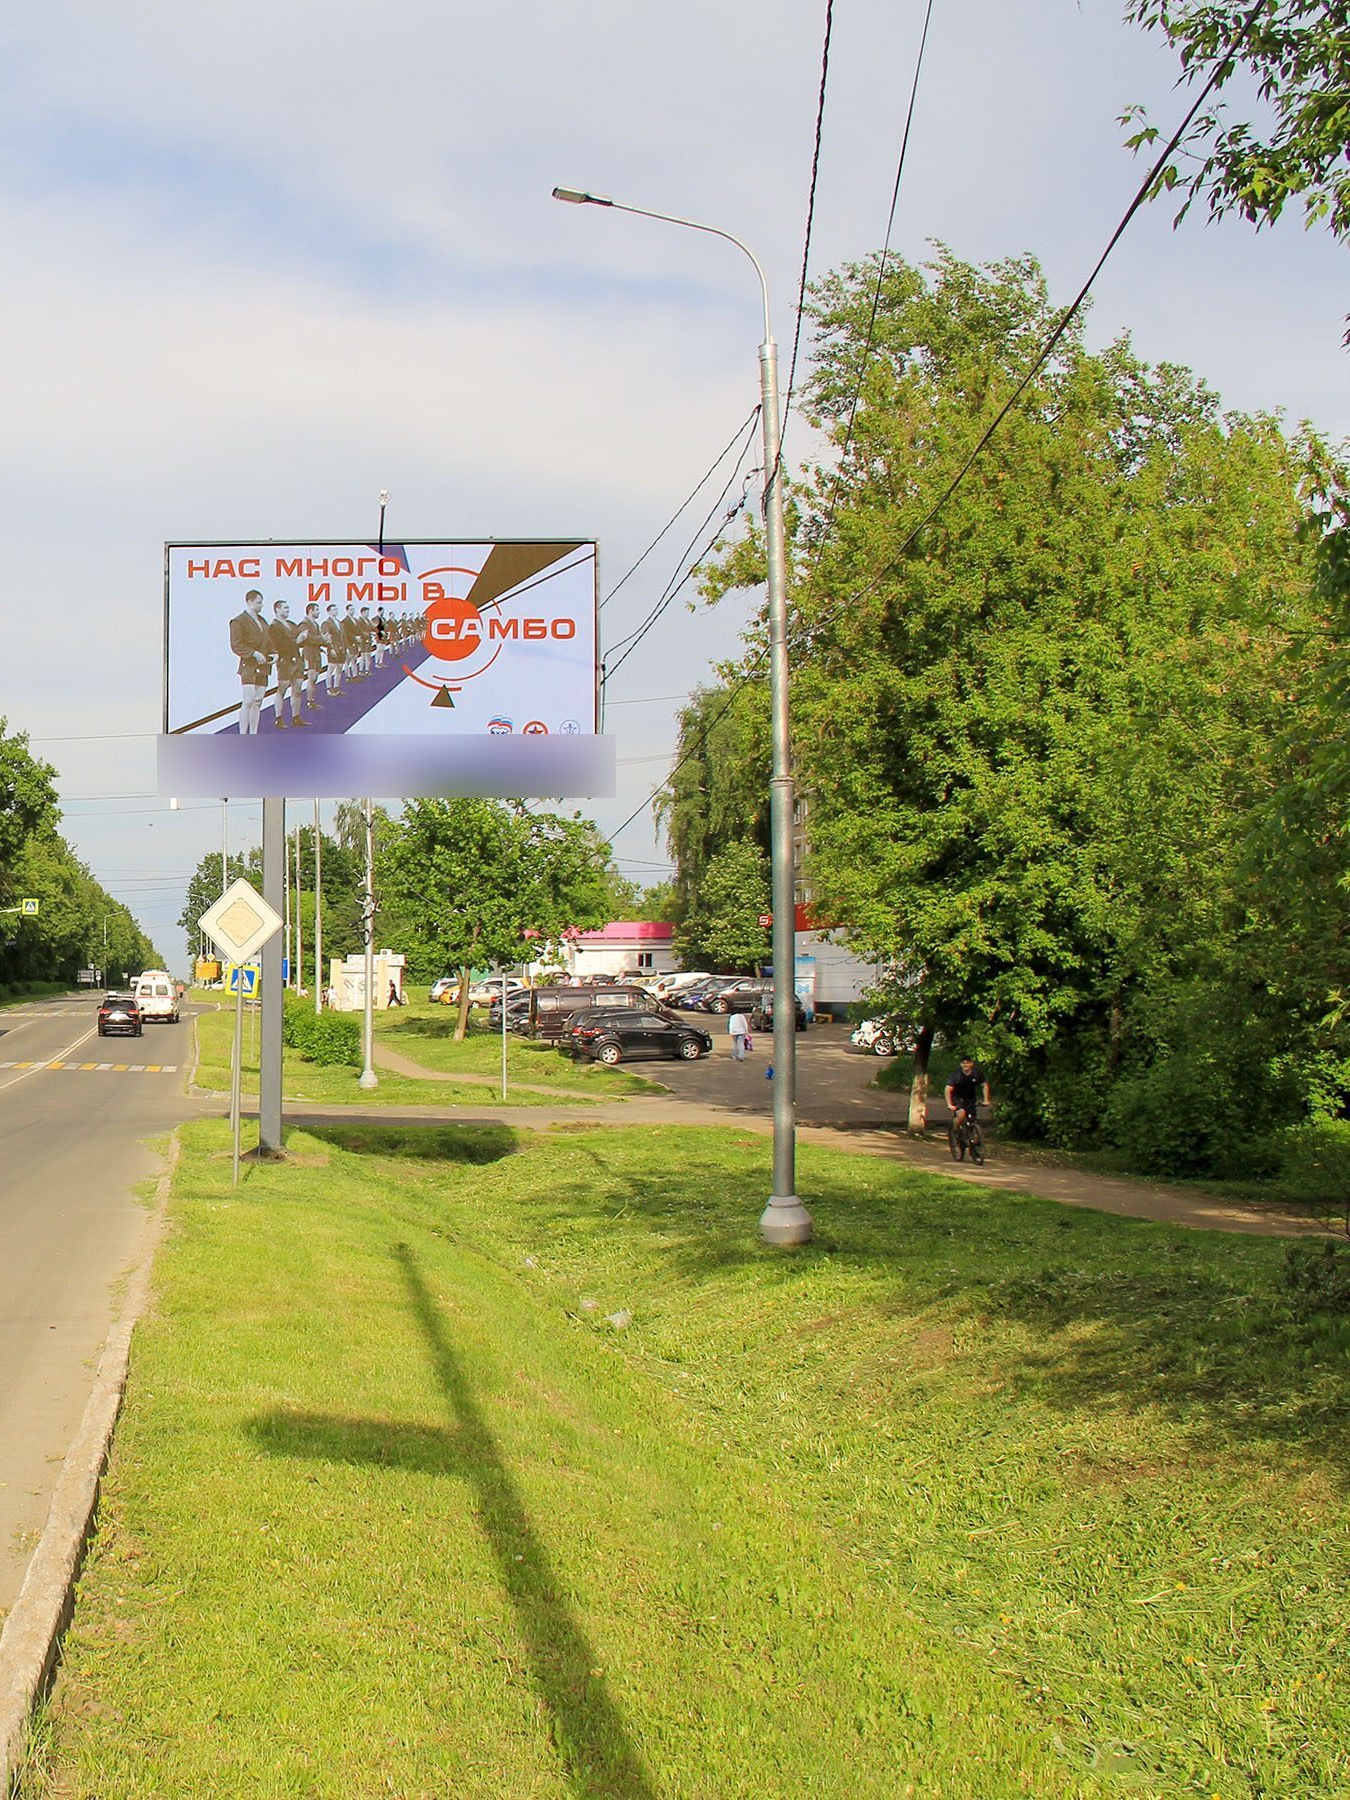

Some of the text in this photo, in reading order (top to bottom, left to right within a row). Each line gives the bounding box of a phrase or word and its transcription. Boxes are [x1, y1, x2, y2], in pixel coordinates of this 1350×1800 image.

[187, 557, 401, 579] НАС МНОГО
[308, 582, 445, 601] И МЫ В
[429, 617, 576, 640] САМБО
